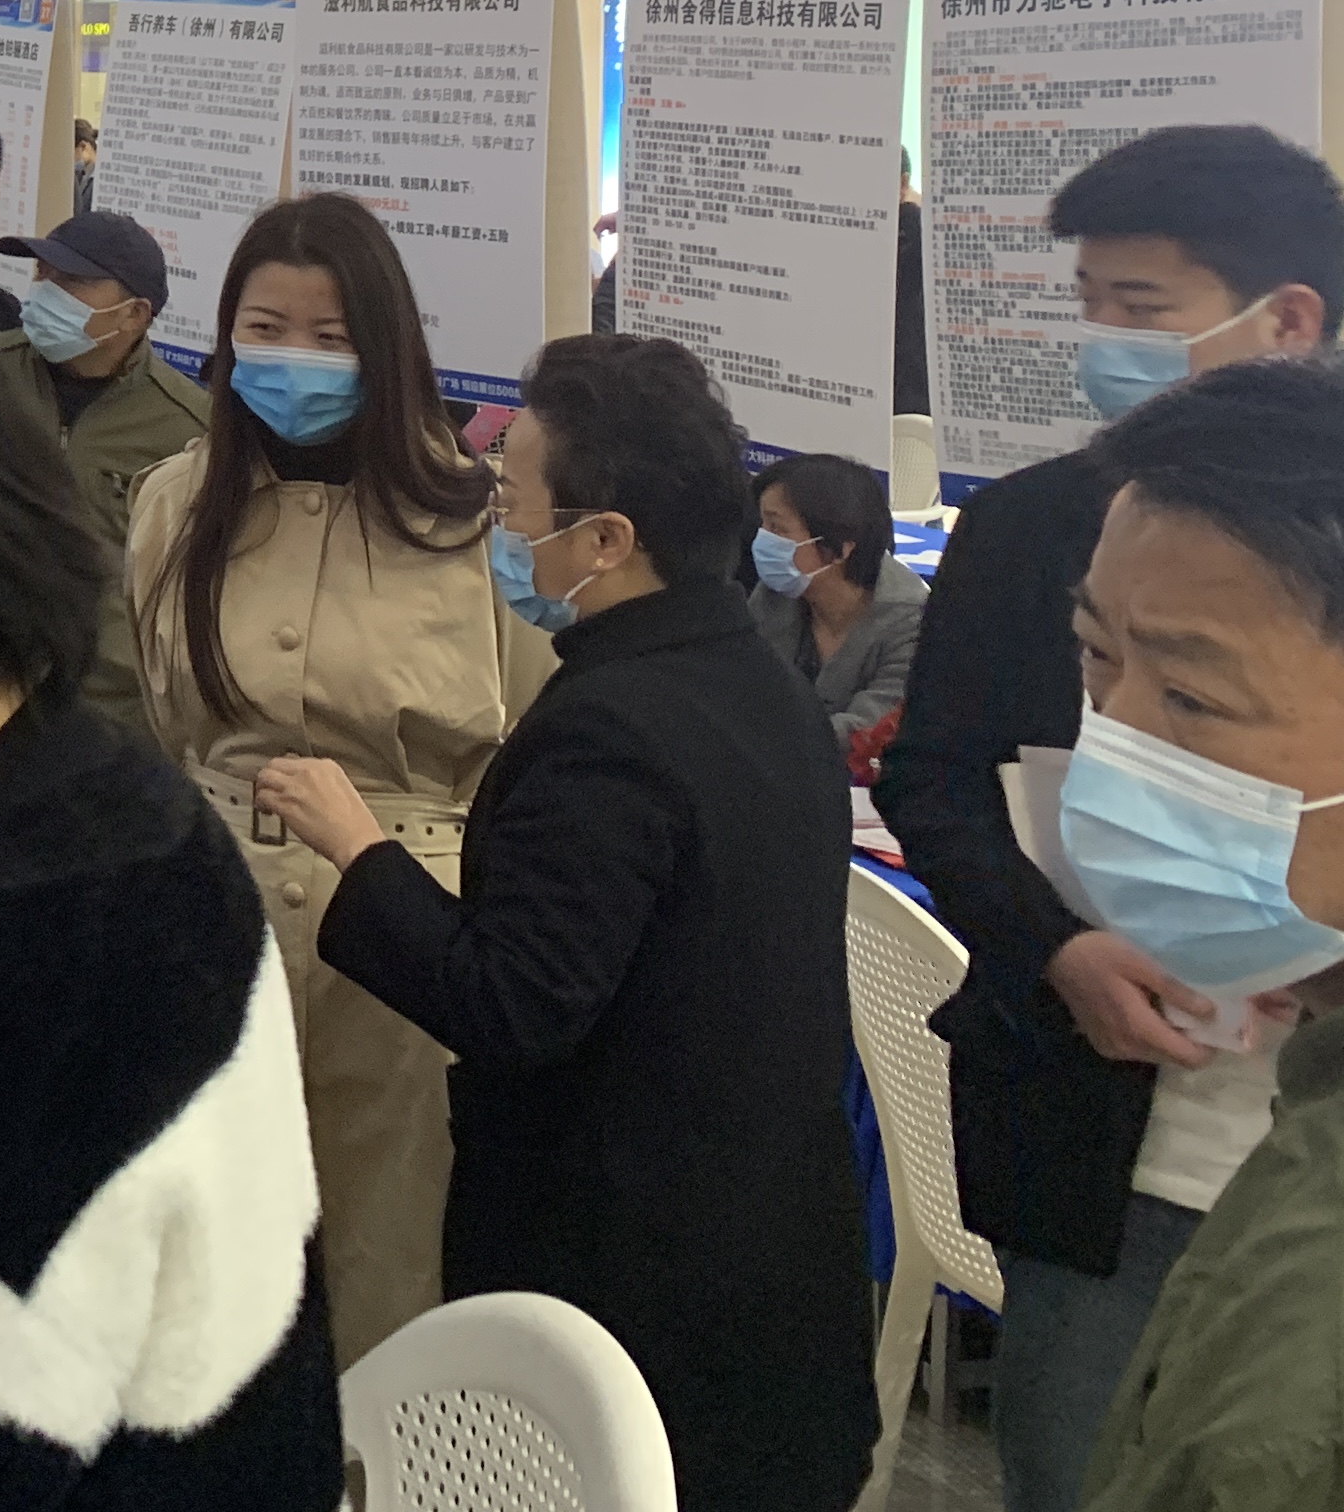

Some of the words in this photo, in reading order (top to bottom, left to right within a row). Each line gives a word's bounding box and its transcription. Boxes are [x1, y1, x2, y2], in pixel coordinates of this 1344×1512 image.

[128, 13, 285, 43] 吾行养车（徐州）有限公司
